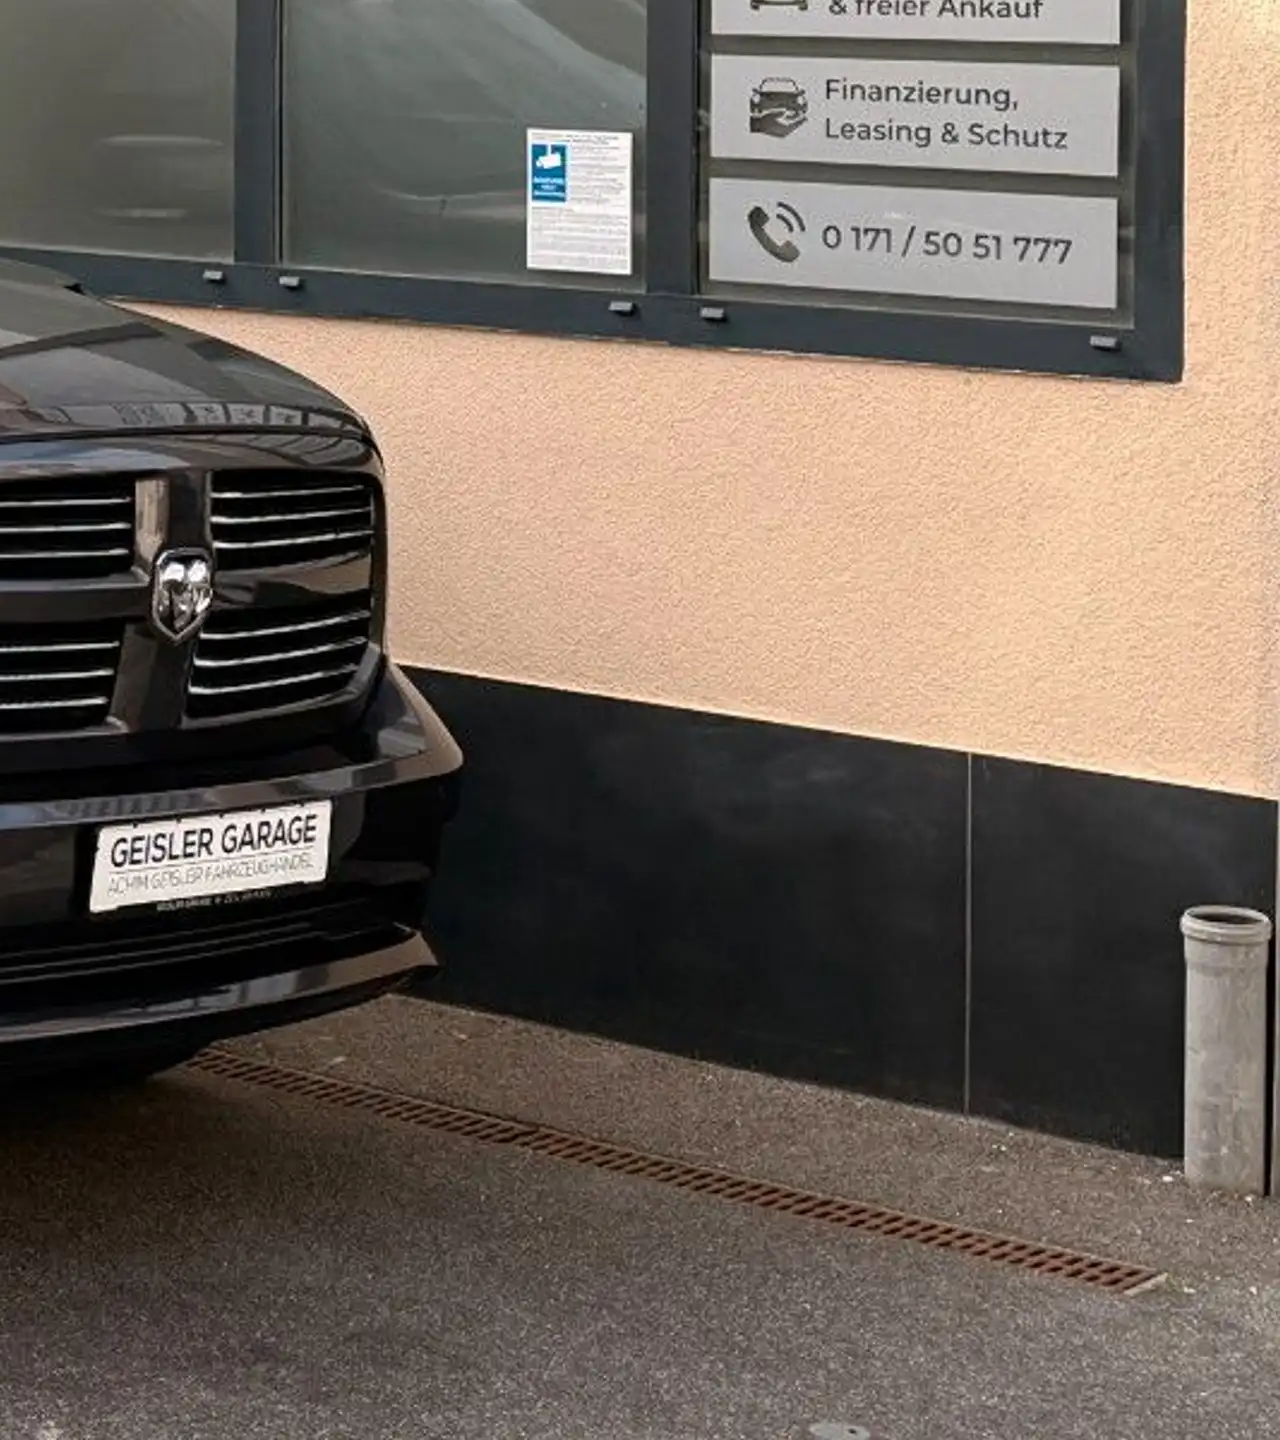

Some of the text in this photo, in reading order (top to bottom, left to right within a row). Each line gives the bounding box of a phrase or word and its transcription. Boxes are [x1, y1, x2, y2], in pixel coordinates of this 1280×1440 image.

[826, 78, 1017, 111] Finanzierung,
[826, 118, 1067, 149] Leasing & Schutz
[823, 226, 1072, 264] 0 171 / 50 51 777
[111, 814, 317, 867] GEISLER GARAGE
